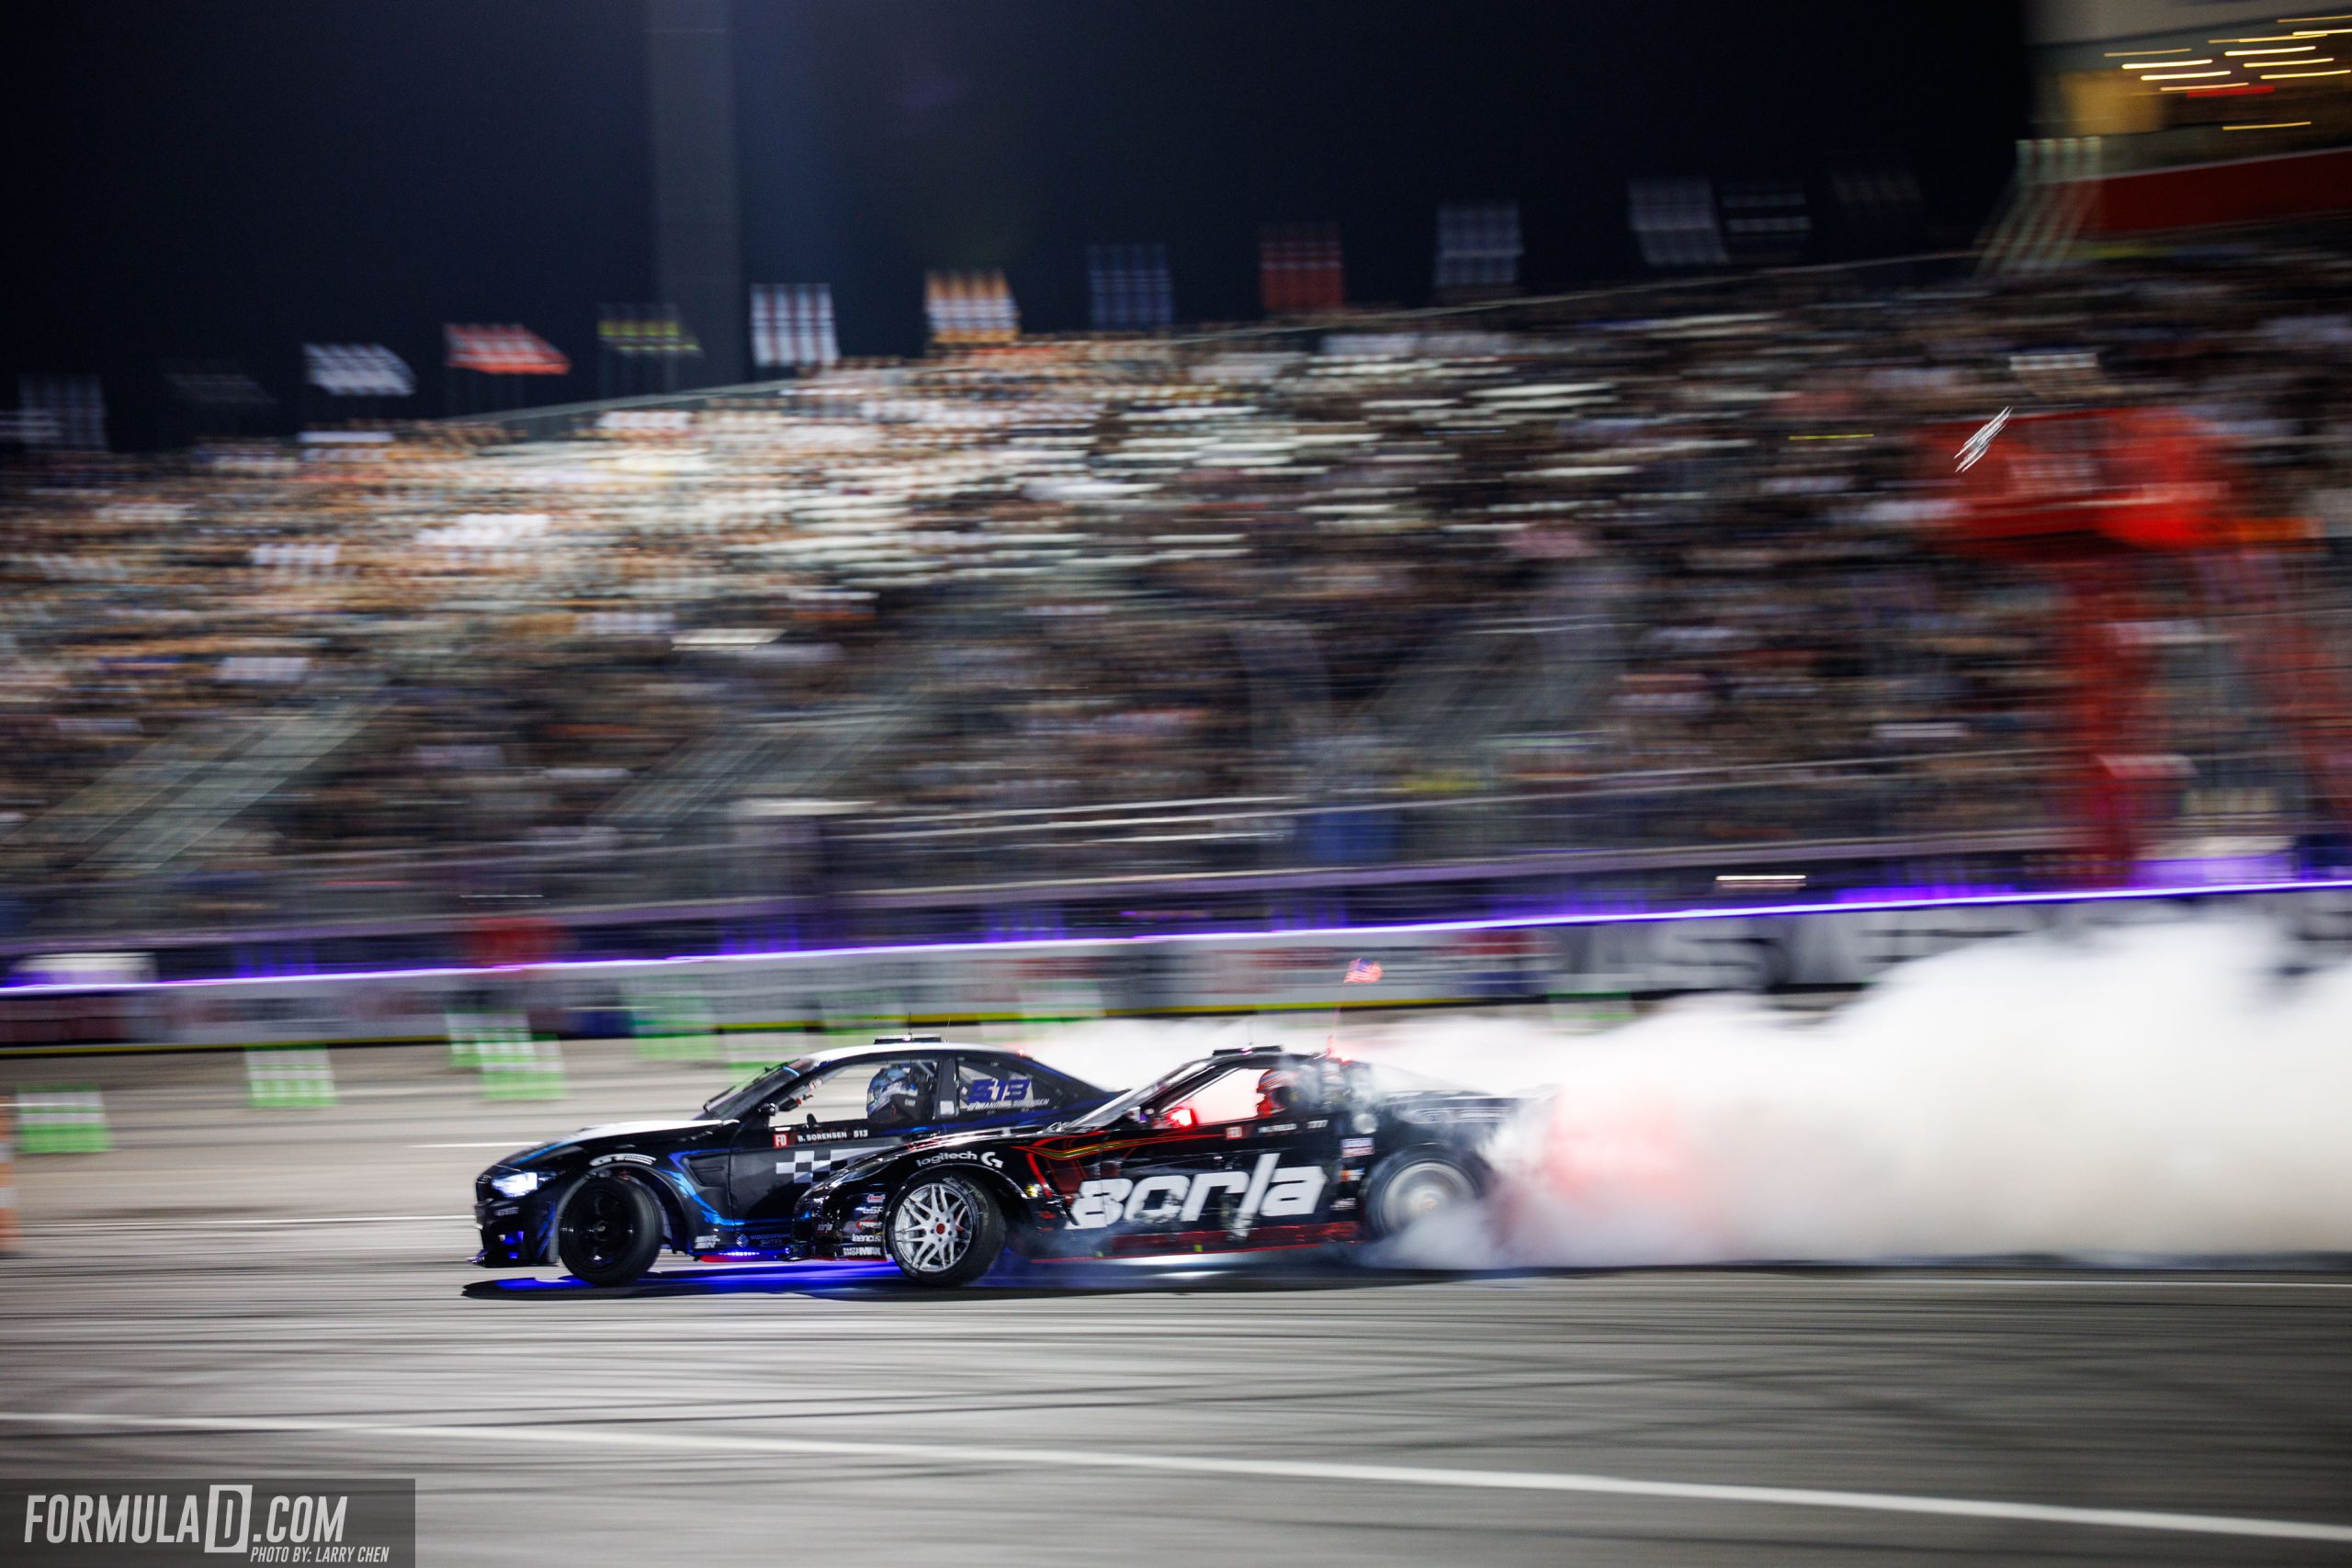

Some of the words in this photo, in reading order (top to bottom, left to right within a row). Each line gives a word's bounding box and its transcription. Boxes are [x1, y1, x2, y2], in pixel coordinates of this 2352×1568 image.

[968, 1078, 1030, 1103] 513
[775, 1134, 787, 1147] FD
[797, 1134, 806, 1143] B.
[806, 1131, 847, 1141] SORENSEN
[854, 1129, 868, 1138] 513
[916, 1151, 978, 1168] logitech
